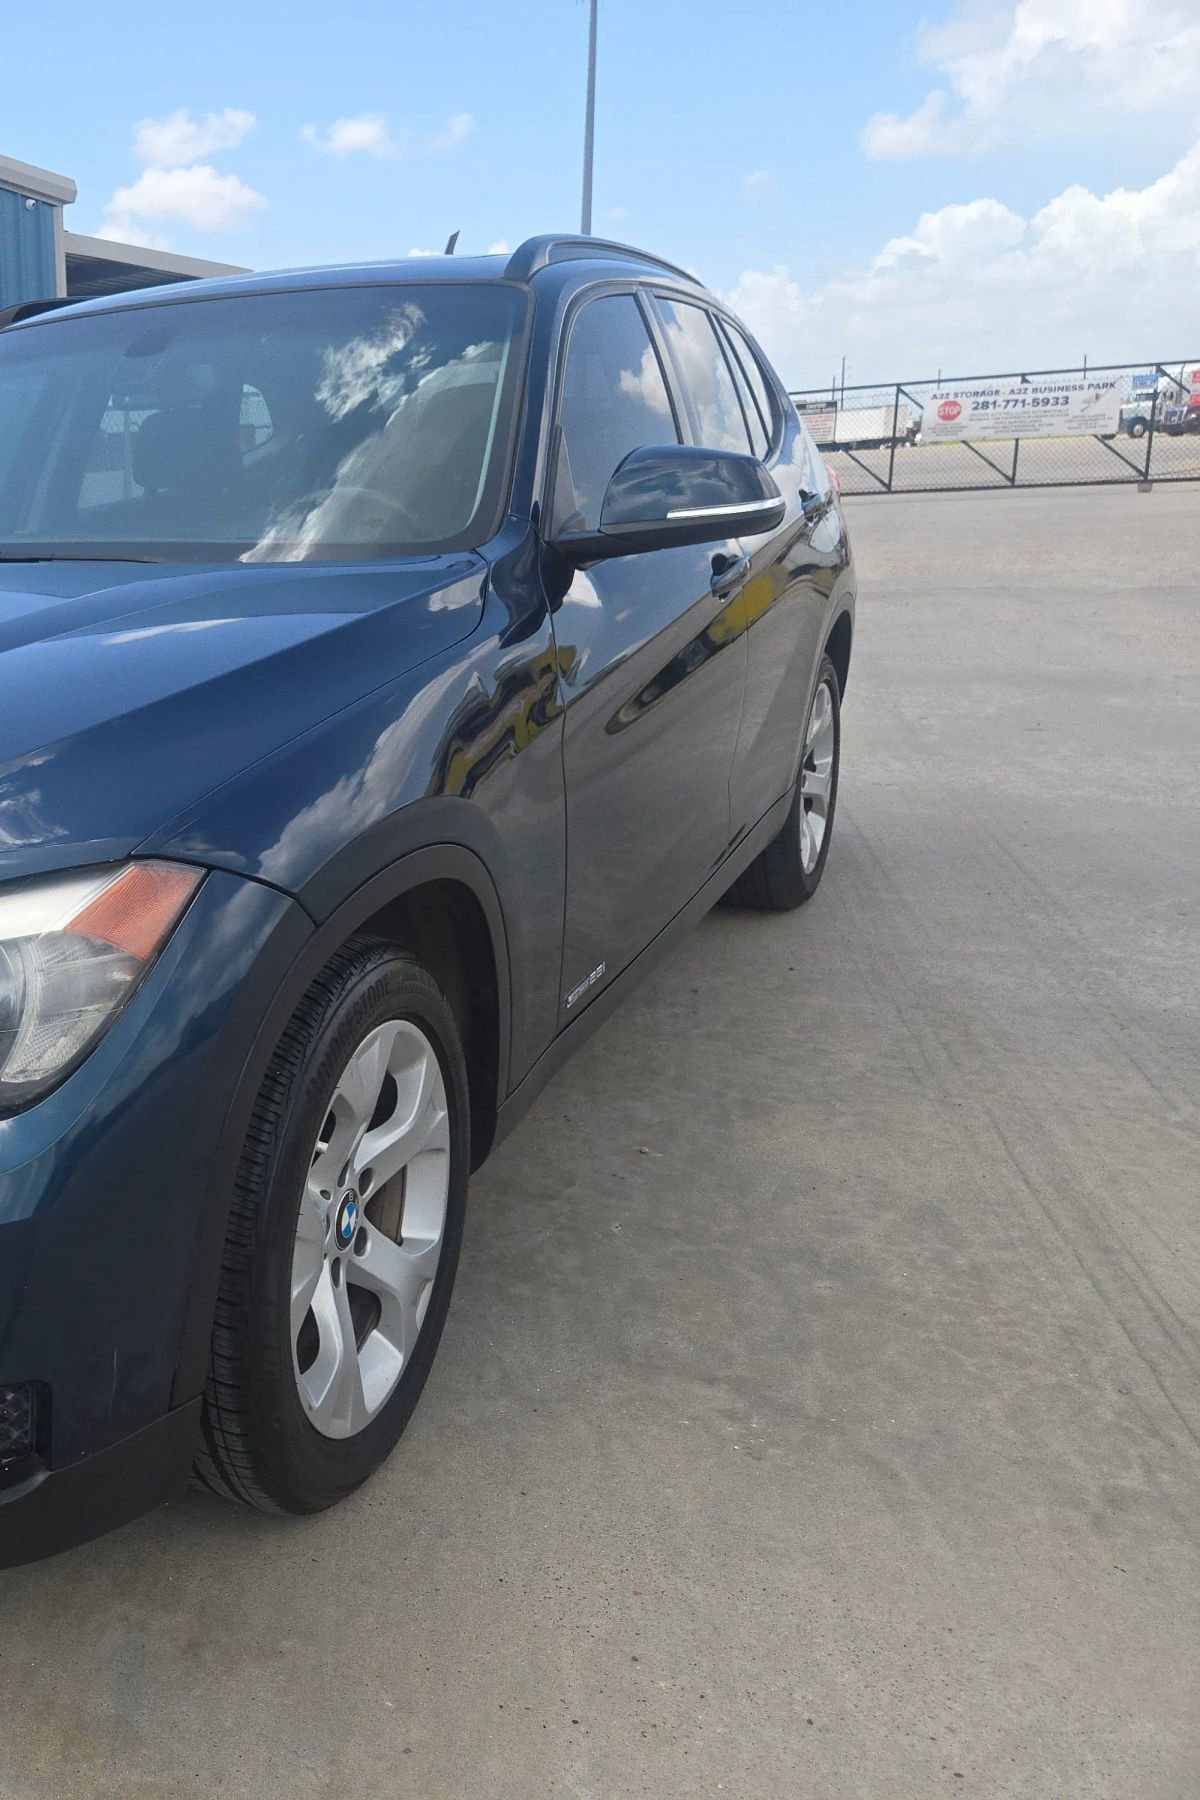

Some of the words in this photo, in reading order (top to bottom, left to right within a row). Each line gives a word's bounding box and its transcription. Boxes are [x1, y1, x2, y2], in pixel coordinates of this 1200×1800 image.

[953, 389, 1000, 399] STORAGE
[1031, 384, 1084, 394] BUSINESS
[1087, 382, 1117, 391] PARK
[938, 405, 961, 417] STOP
[971, 396, 1070, 411] 281-771-5933
